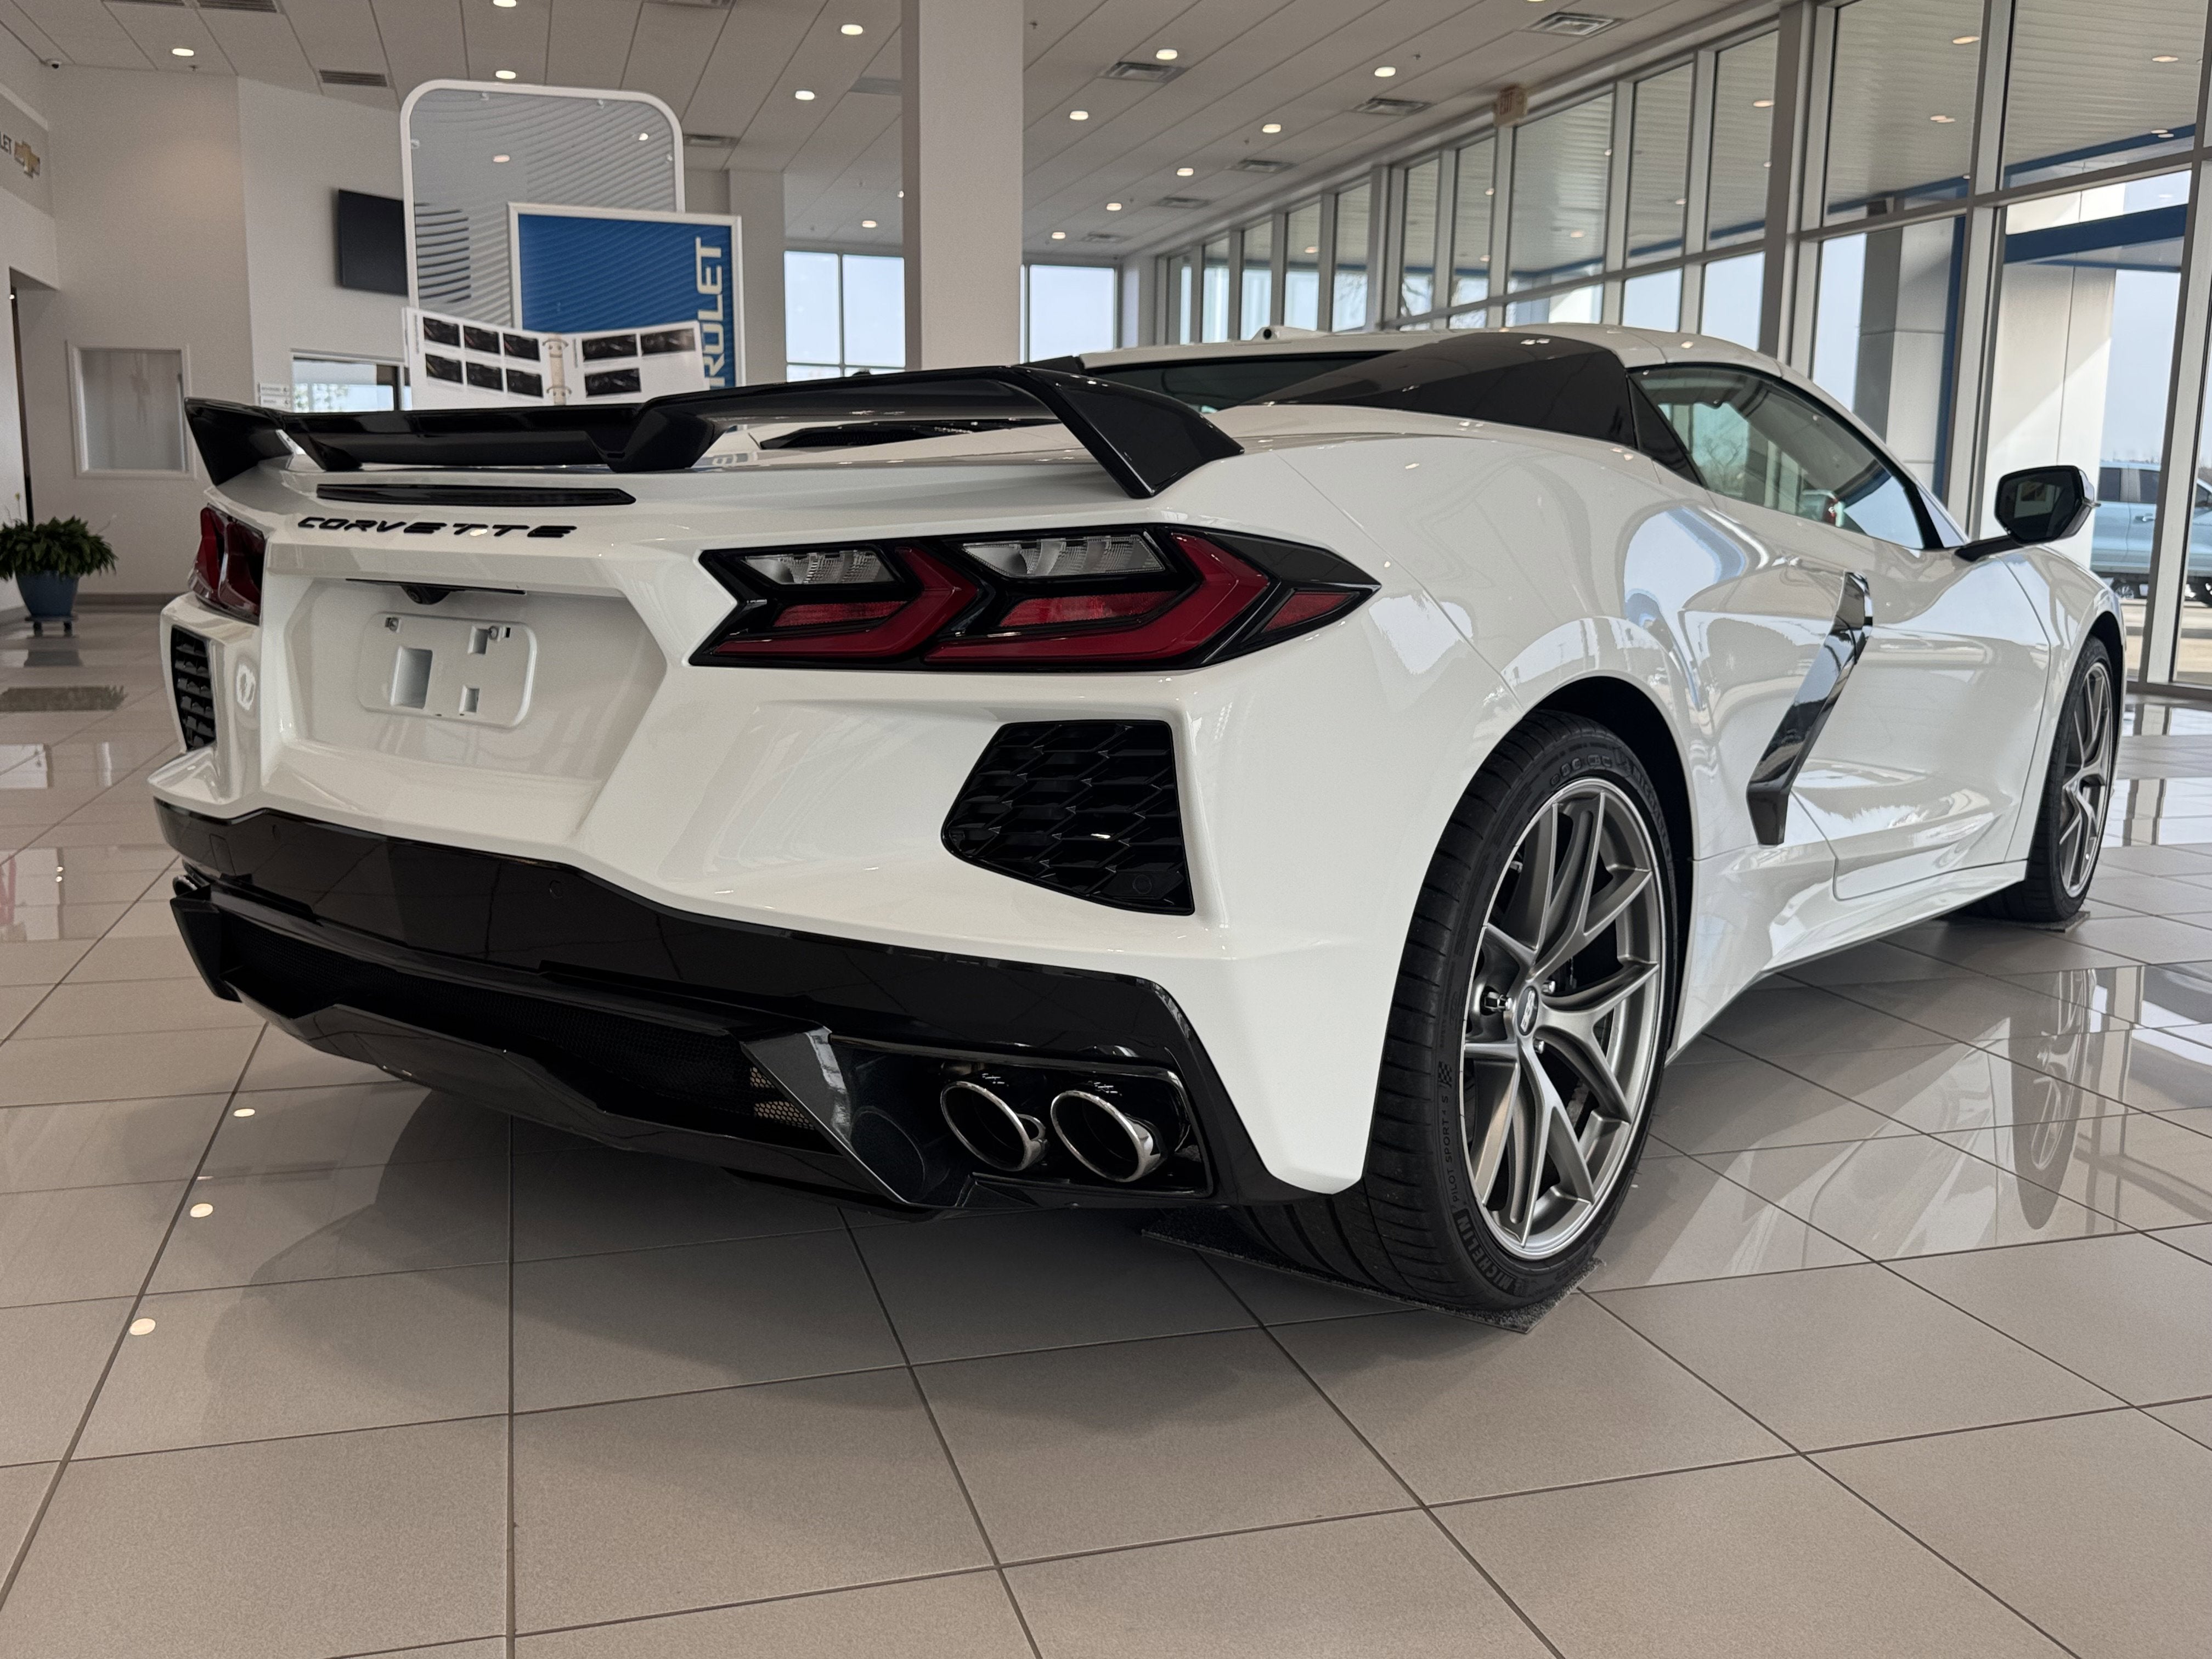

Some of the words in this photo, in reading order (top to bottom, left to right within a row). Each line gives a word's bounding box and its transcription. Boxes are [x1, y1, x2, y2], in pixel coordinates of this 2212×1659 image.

[298, 517, 577, 538] CORVETTE
[1442, 1118, 1453, 1164] SPORT
[1447, 1169, 1459, 1202] PILOT
[1457, 1216, 1514, 1290] MICHELIN
